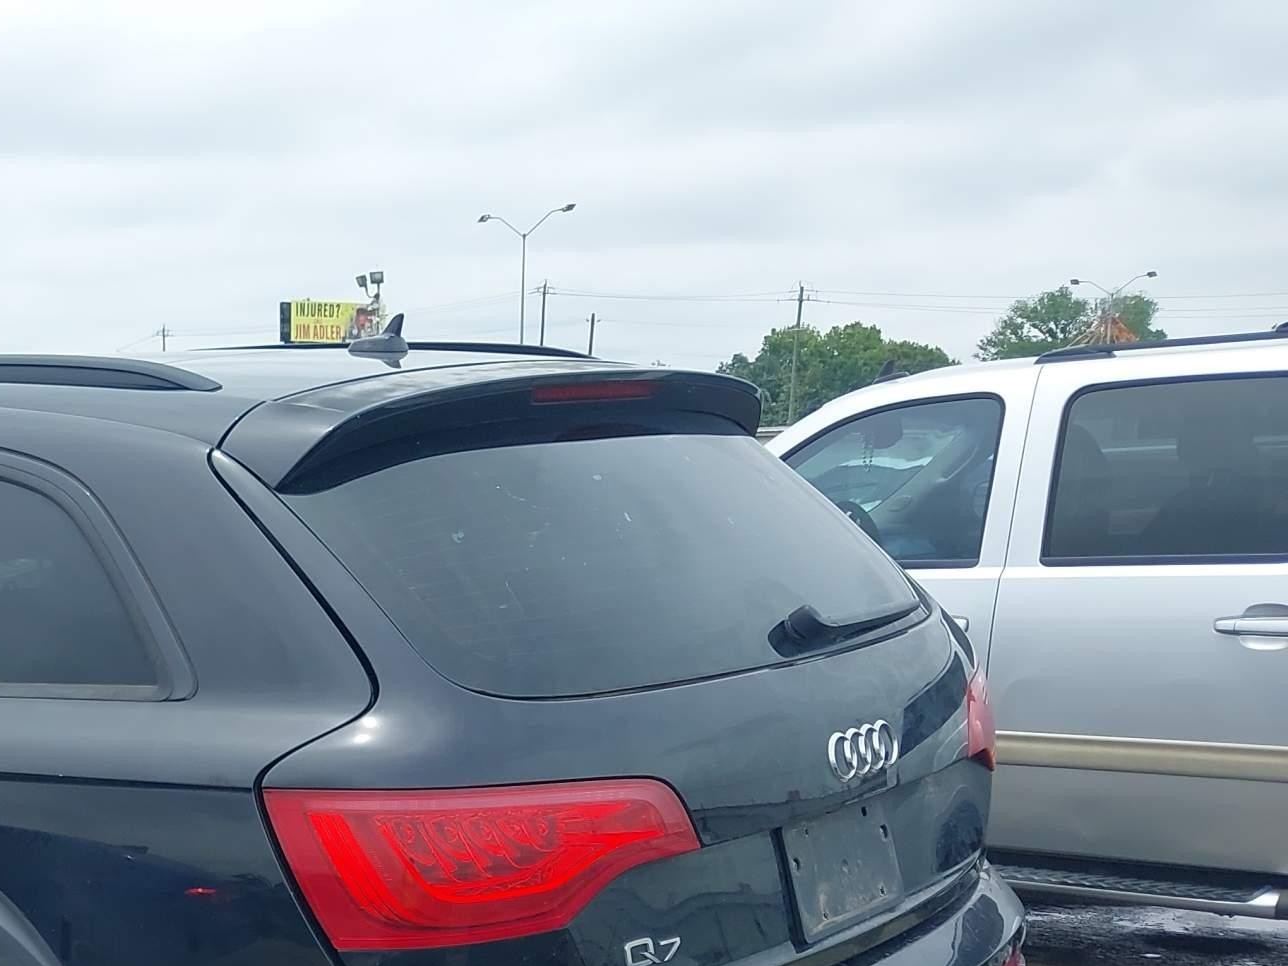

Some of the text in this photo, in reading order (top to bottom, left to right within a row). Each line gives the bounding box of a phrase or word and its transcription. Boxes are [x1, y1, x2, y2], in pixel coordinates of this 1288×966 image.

[295, 302, 341, 318] INJURED?
[295, 323, 342, 340] JIM ADLER
